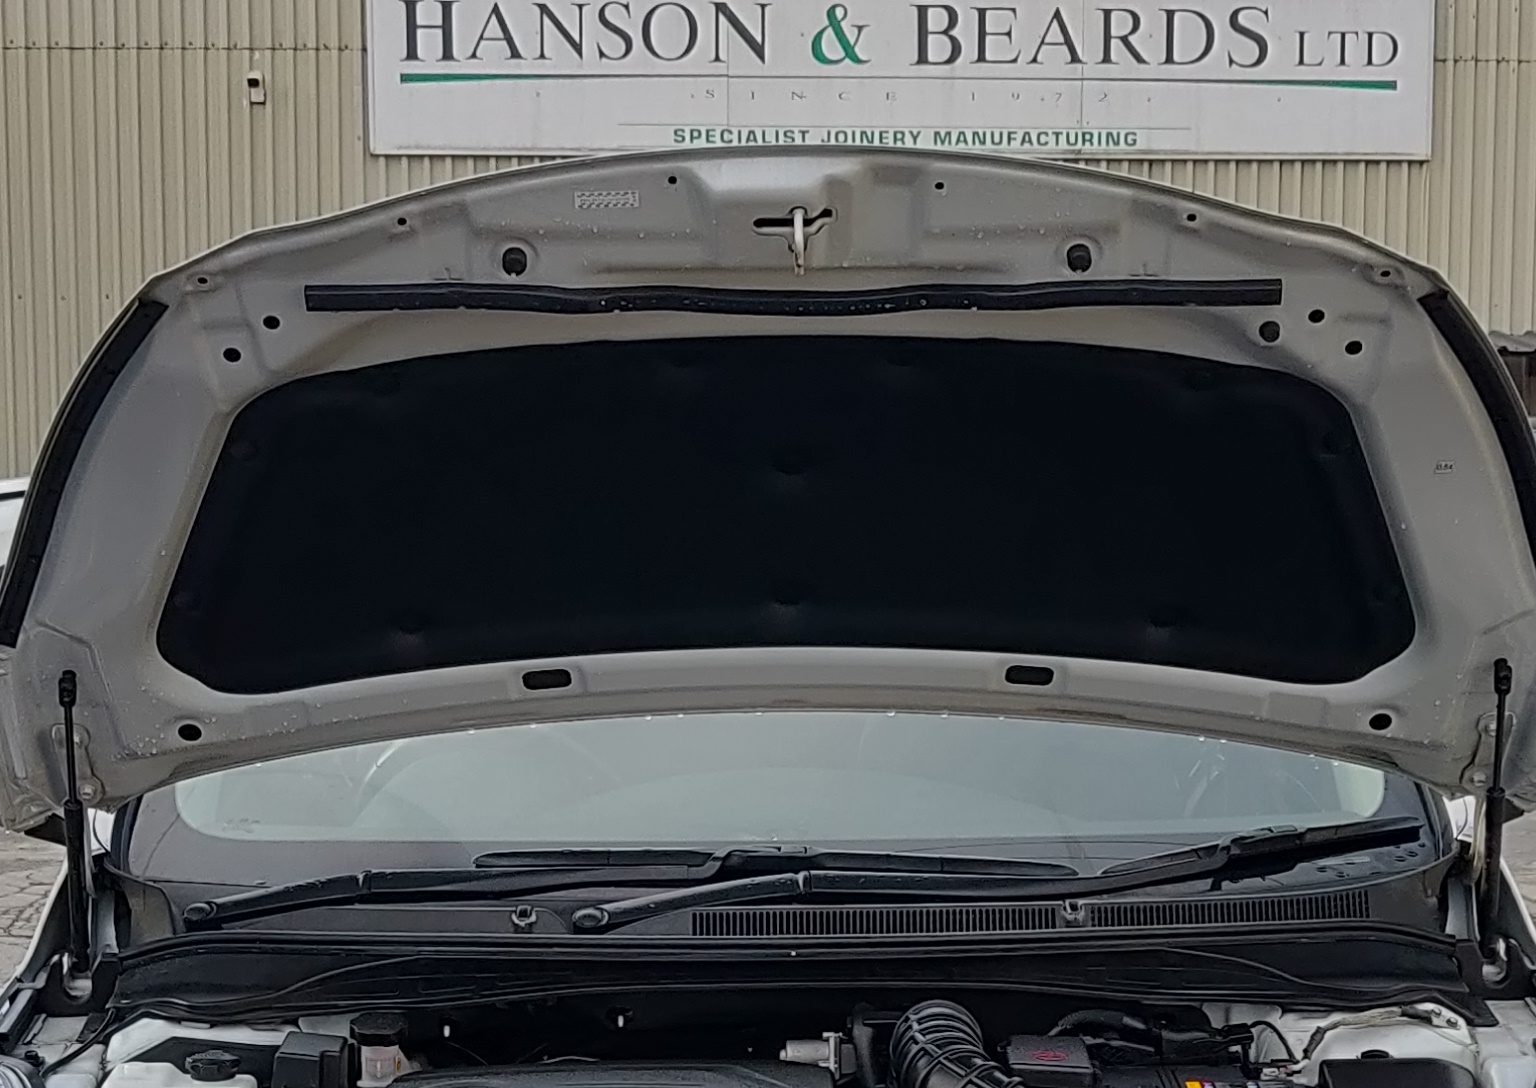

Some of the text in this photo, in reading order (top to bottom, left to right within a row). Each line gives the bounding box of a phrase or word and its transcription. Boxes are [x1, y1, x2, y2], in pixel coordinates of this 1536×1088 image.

[399, 0, 1400, 69] HANSON & BEARDS LTD
[703, 88, 898, 102] SINCE
[672, 128, 1139, 149] SPECIALIST JOINERY MANUFACTURING
